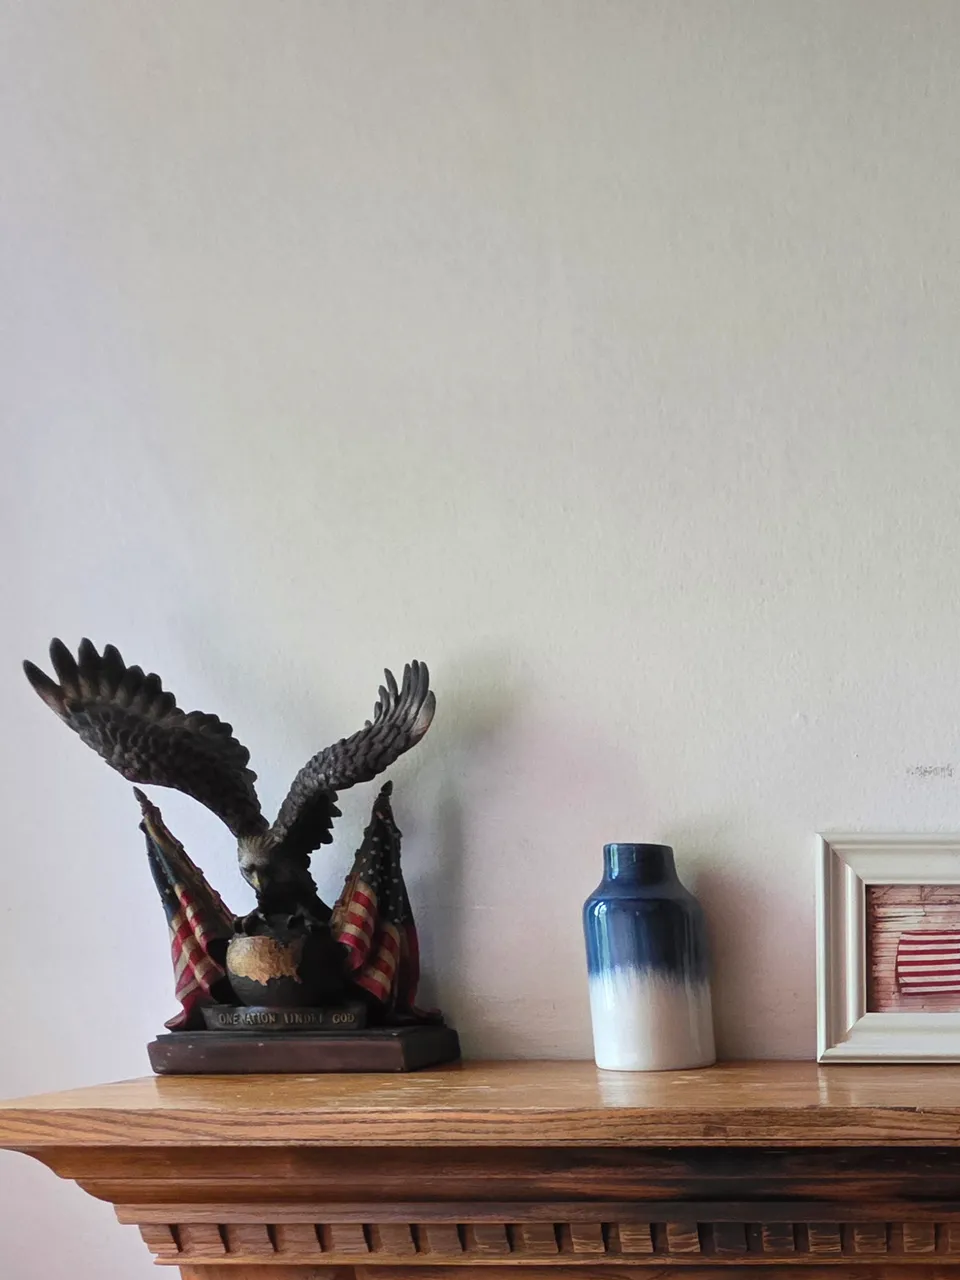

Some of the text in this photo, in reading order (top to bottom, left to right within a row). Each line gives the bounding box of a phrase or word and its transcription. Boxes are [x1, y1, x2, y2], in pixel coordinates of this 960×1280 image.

[218, 1012, 238, 1025] ONE
[239, 1012, 276, 1025] NATION
[332, 1012, 355, 1024] GOD
